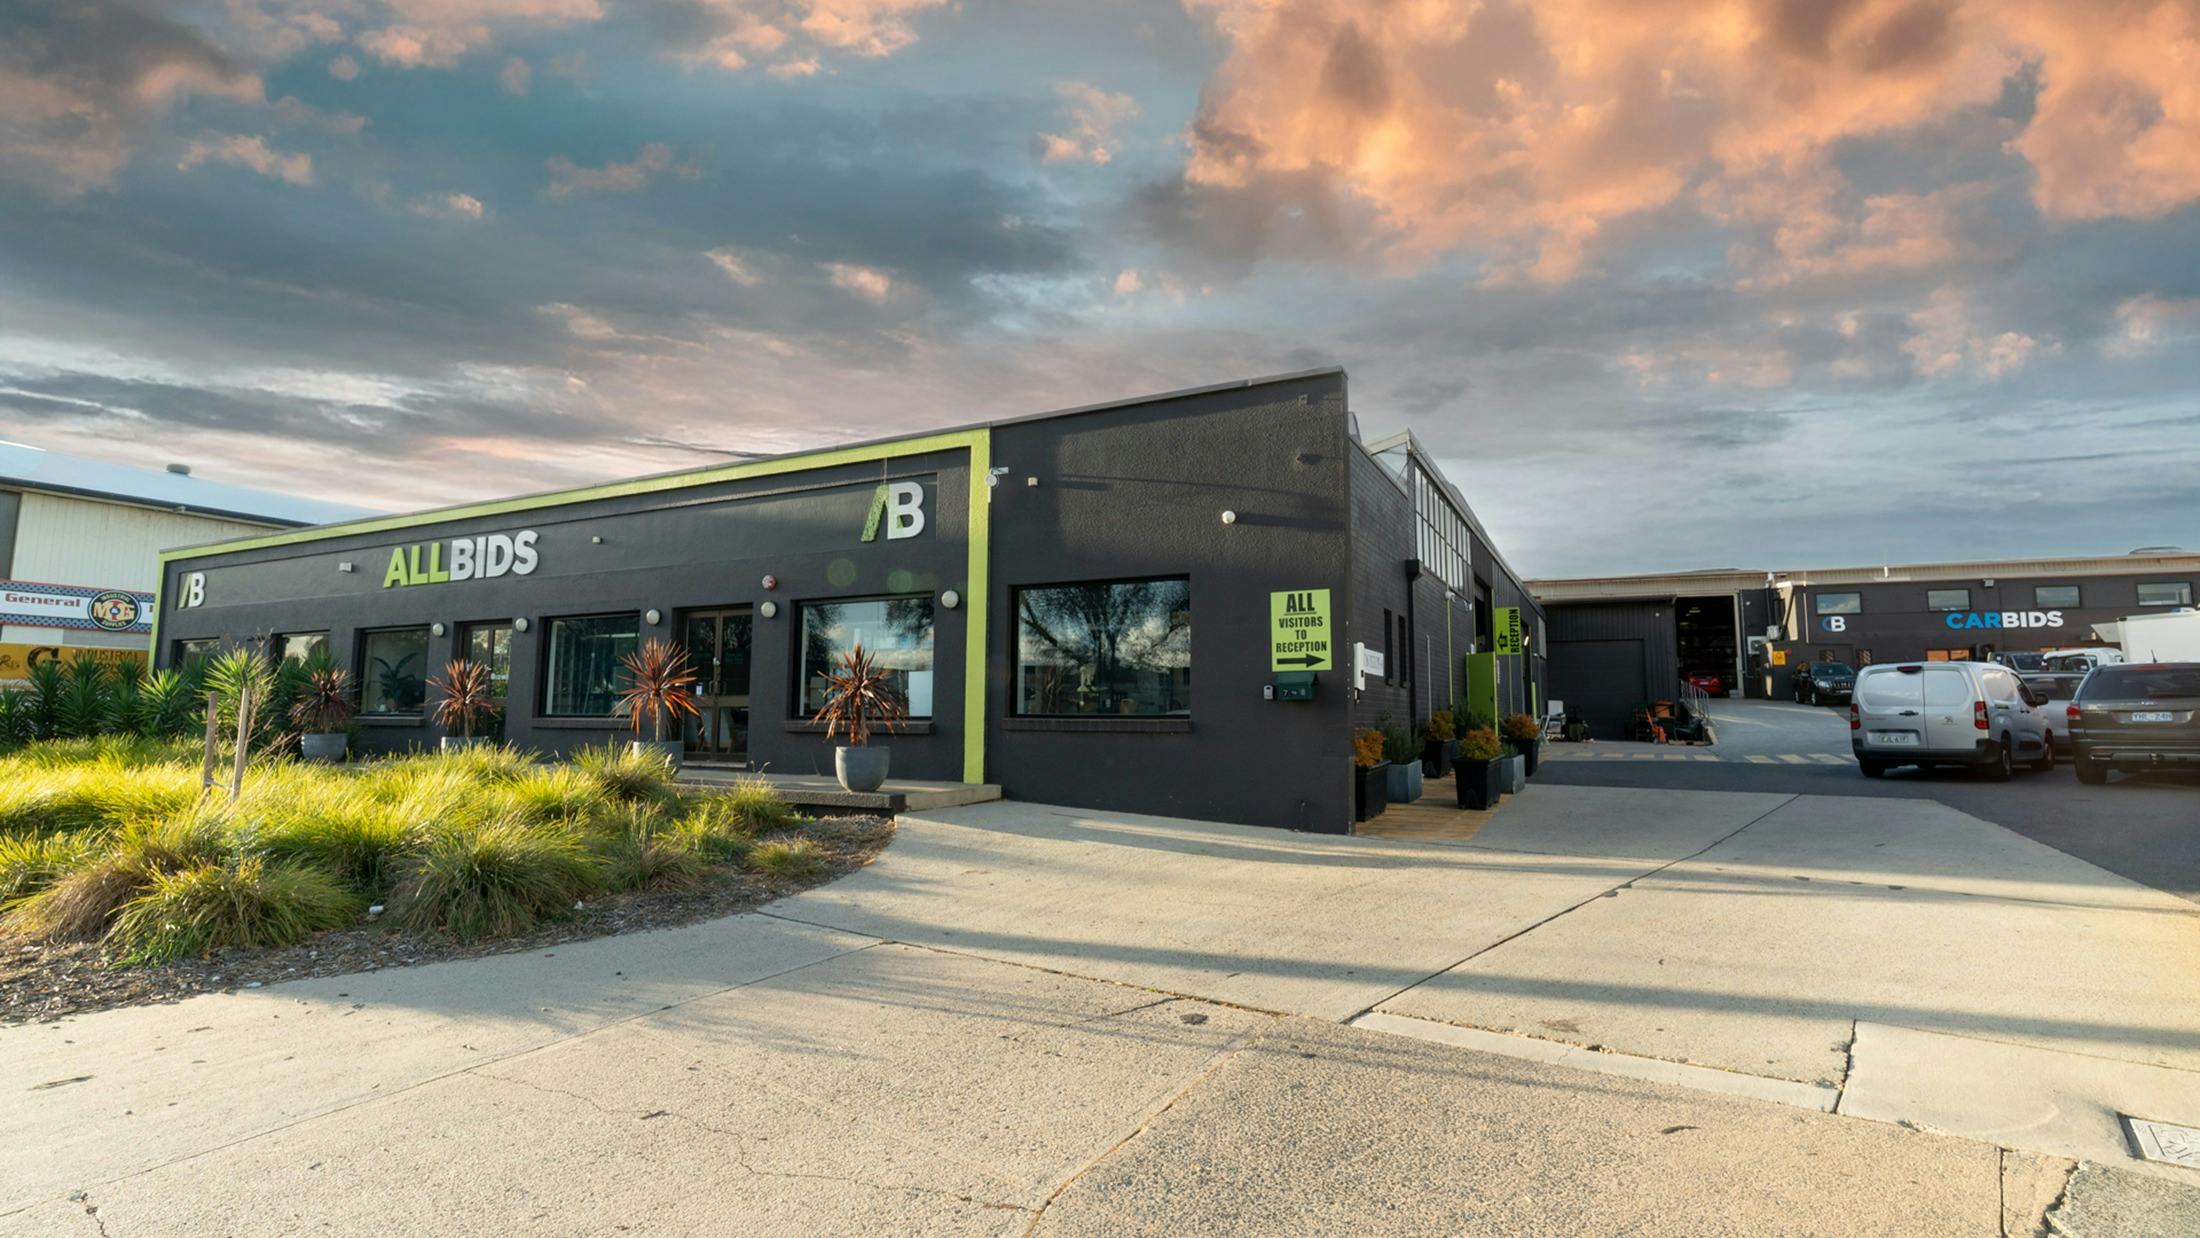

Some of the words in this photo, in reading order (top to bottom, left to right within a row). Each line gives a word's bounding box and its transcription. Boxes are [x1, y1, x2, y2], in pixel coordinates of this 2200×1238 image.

[383, 530, 539, 588] ALLBIDS
[5, 593, 80, 608] General
[1286, 592, 1315, 612] ALL
[1278, 616, 1323, 628] VISITORS
[1945, 610, 2064, 629] CARBIDS
[1295, 629, 1307, 640] TO
[1508, 608, 1520, 653] RECEPTION
[1275, 641, 1327, 653] RECEPTION
